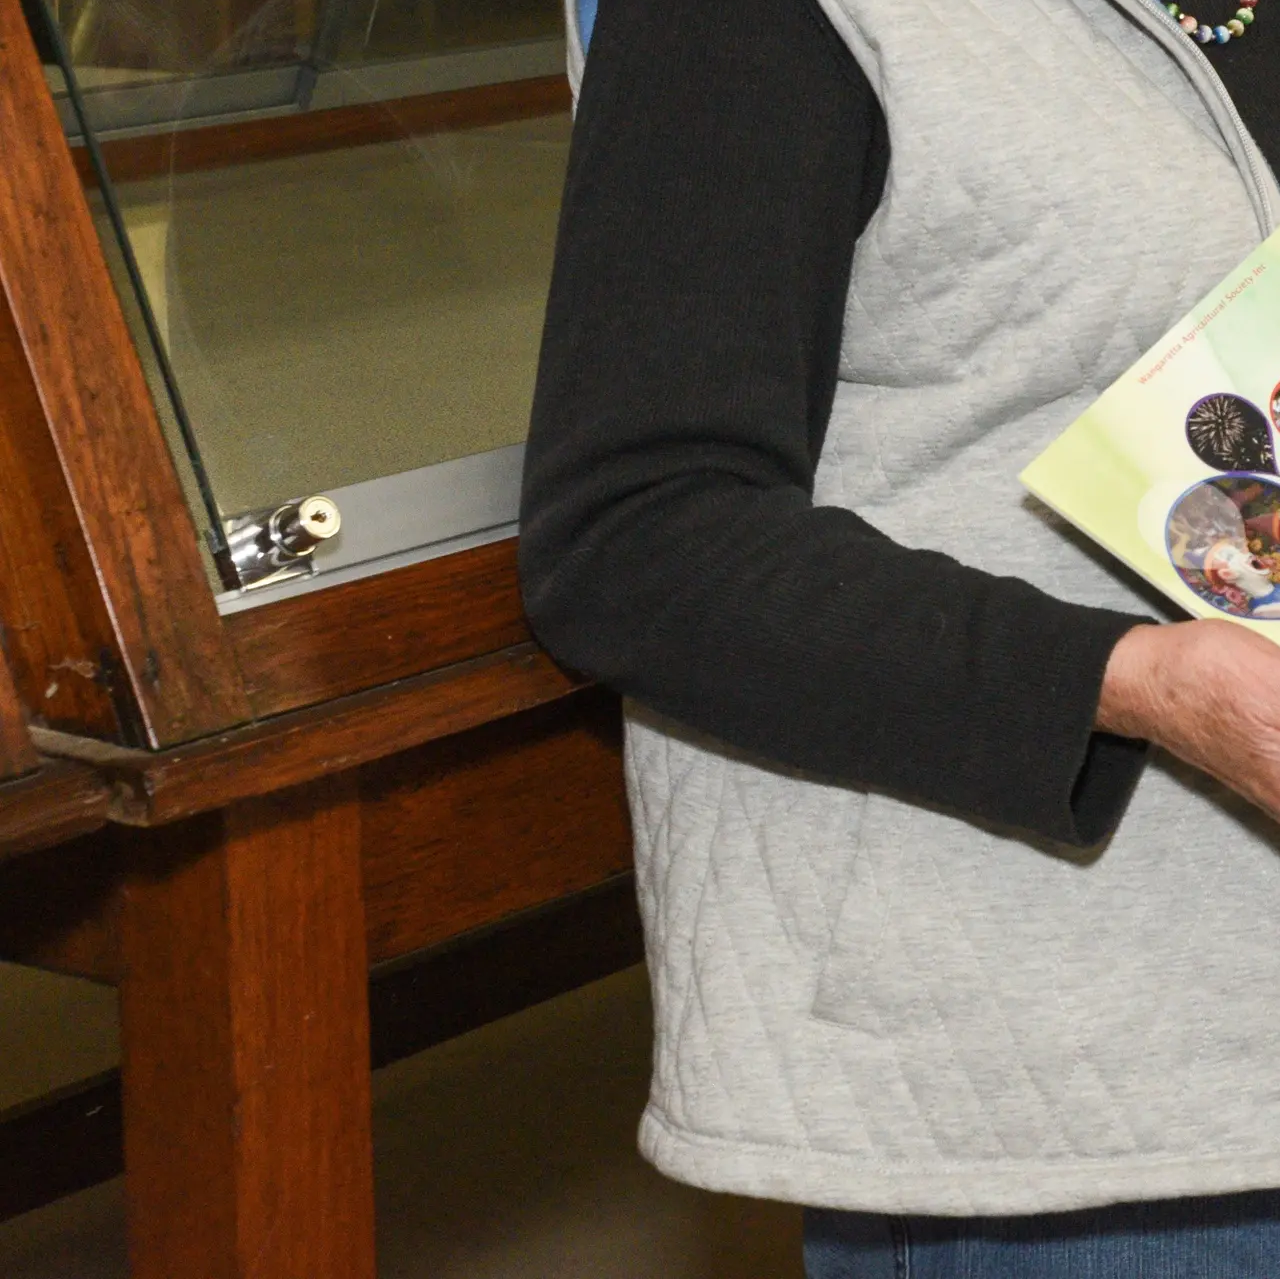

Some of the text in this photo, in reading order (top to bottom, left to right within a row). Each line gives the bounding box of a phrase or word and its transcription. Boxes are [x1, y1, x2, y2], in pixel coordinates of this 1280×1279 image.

[1138, 263, 1266, 385] Wangaratta Agricultural Society Inc
